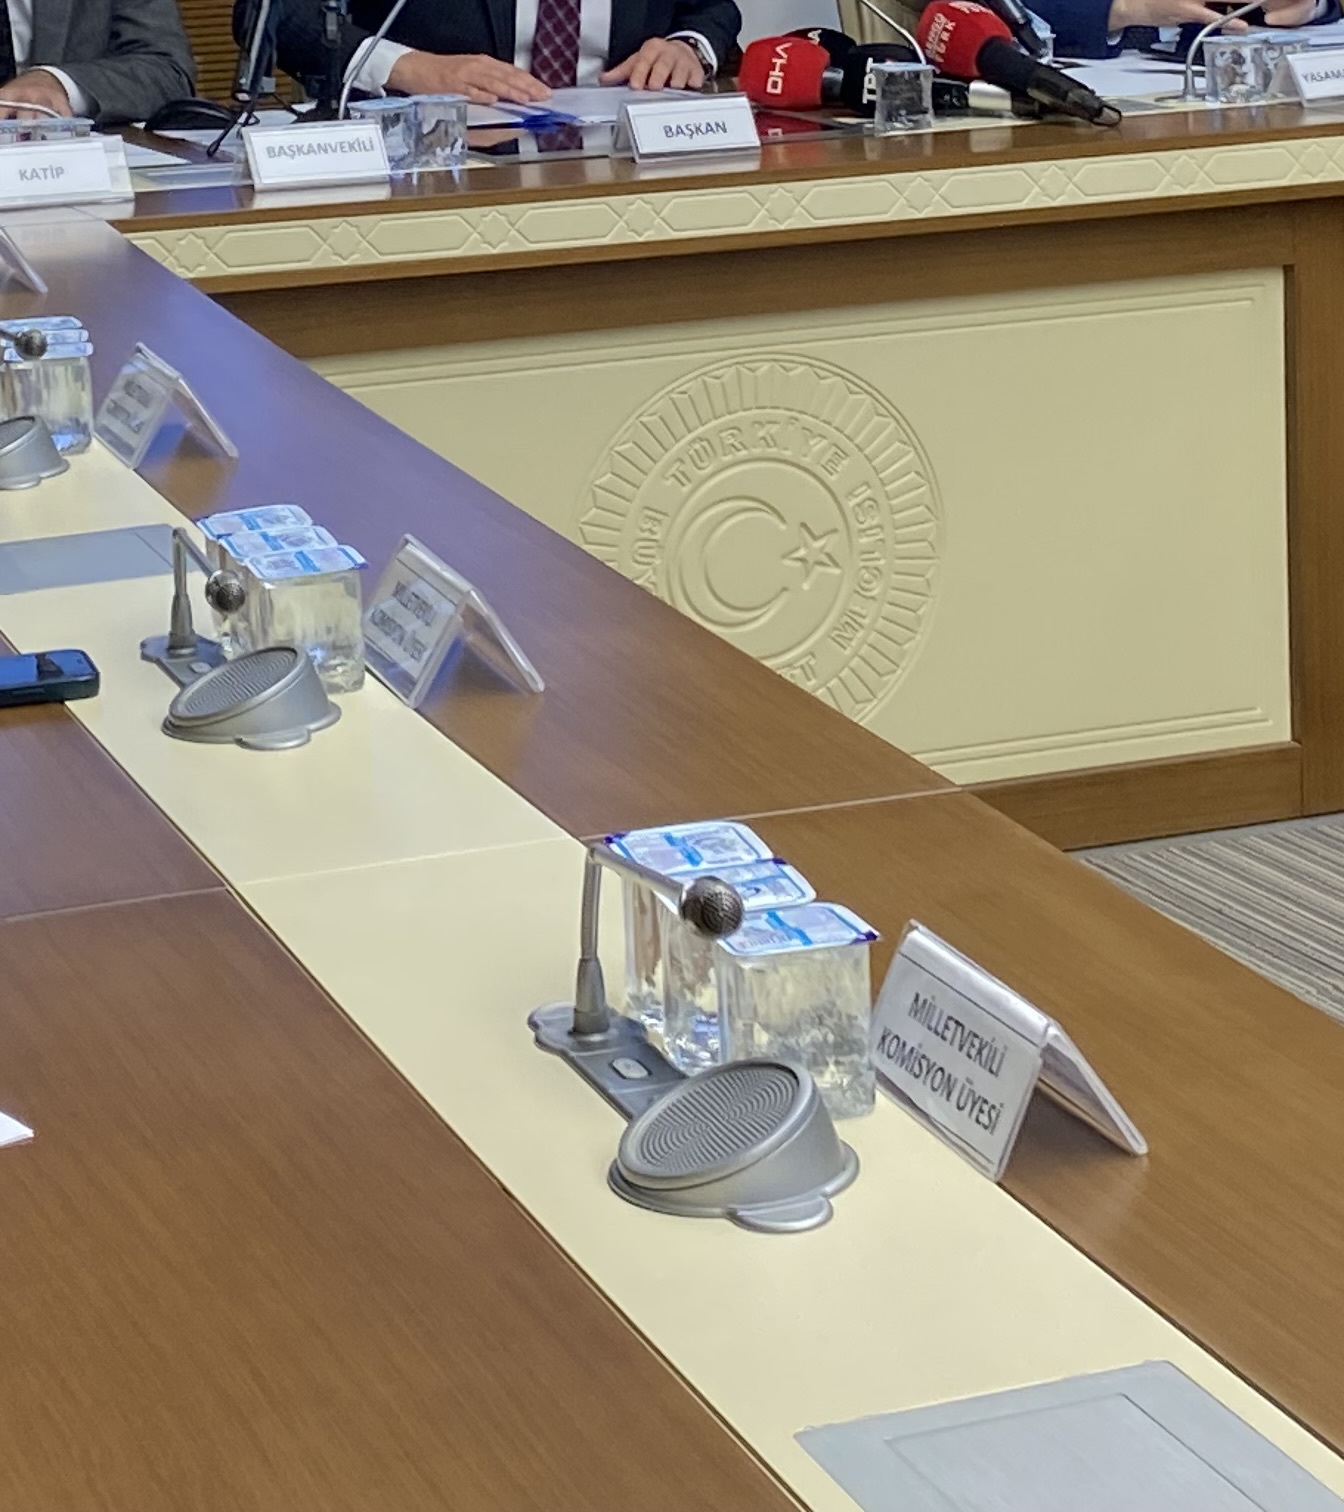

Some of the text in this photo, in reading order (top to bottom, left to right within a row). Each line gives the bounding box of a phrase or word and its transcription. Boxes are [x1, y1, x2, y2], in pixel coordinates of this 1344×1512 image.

[663, 119, 728, 141] BAŞKAN
[265, 139, 375, 161] BAŞKANVEKİLİ
[18, 164, 65, 182] KATİP
[909, 992, 1007, 1076] MİLLETVEKİLİ
[876, 1025, 1004, 1135] KOMİSYON ÜYESİ
